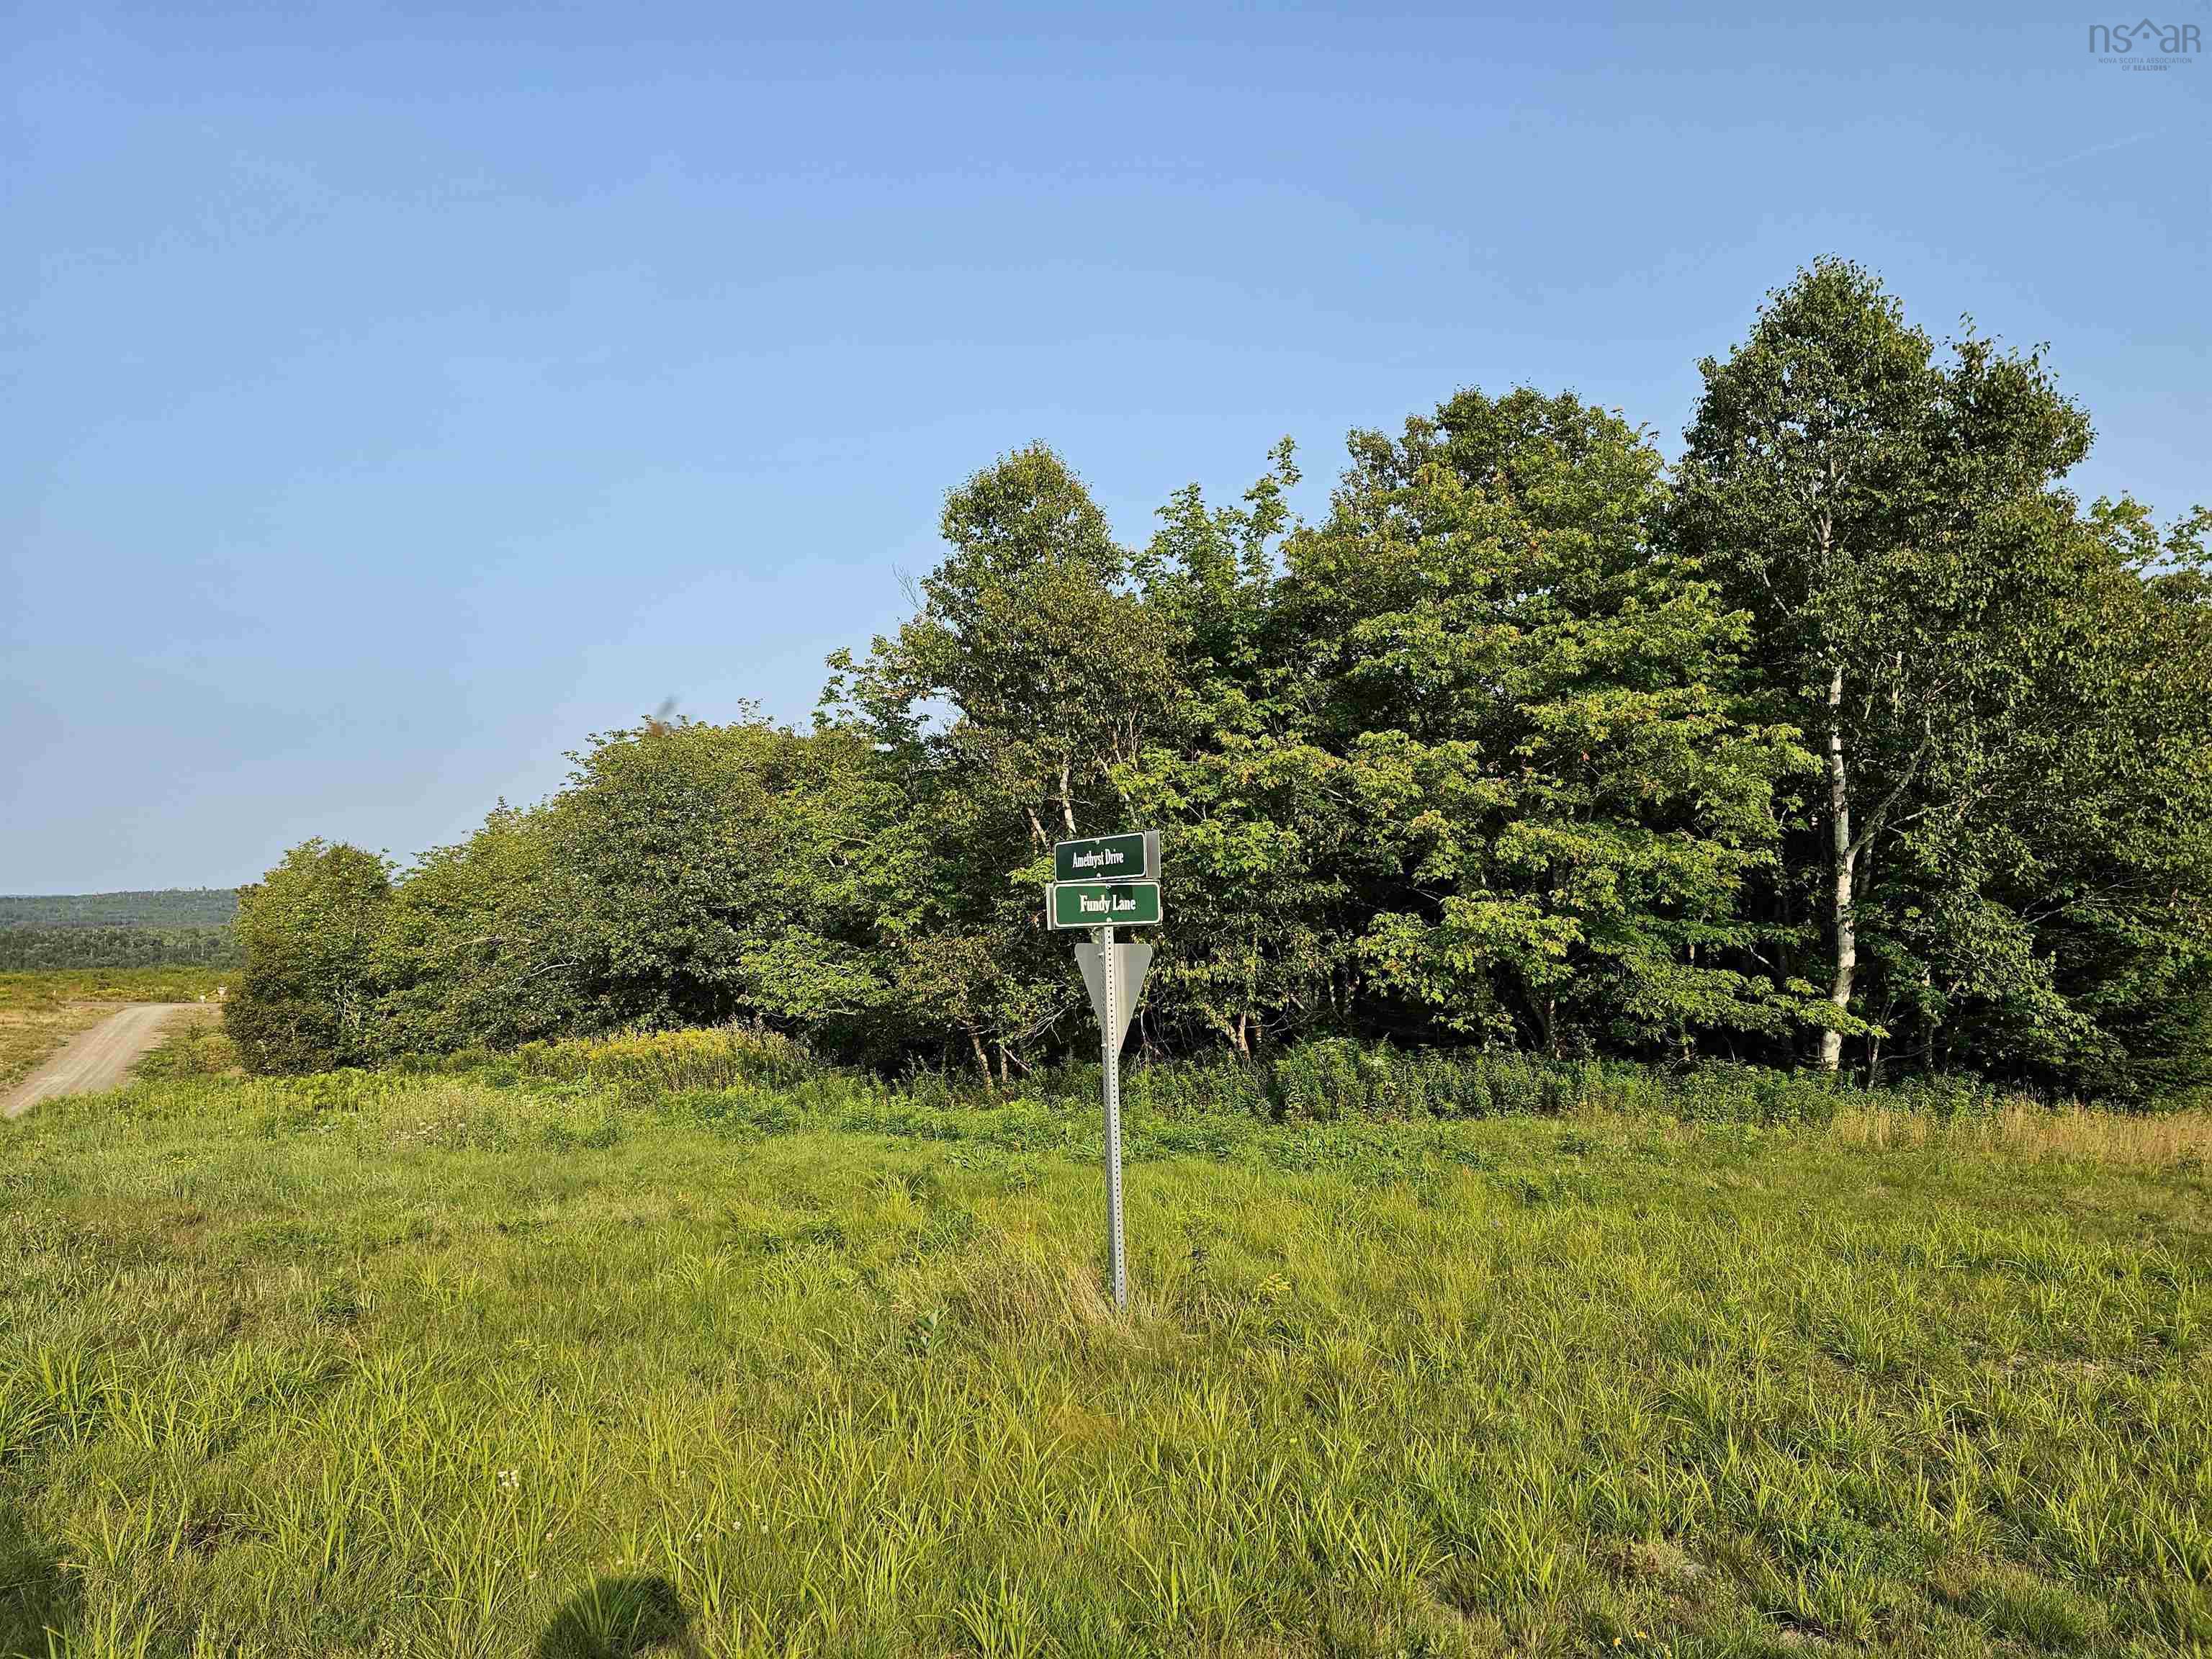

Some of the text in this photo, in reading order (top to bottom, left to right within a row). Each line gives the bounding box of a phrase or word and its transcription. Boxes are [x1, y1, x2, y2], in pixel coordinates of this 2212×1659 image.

[1072, 848, 1124, 868] Amethyst Drive
[1079, 894, 1136, 913] Fundy Lane
